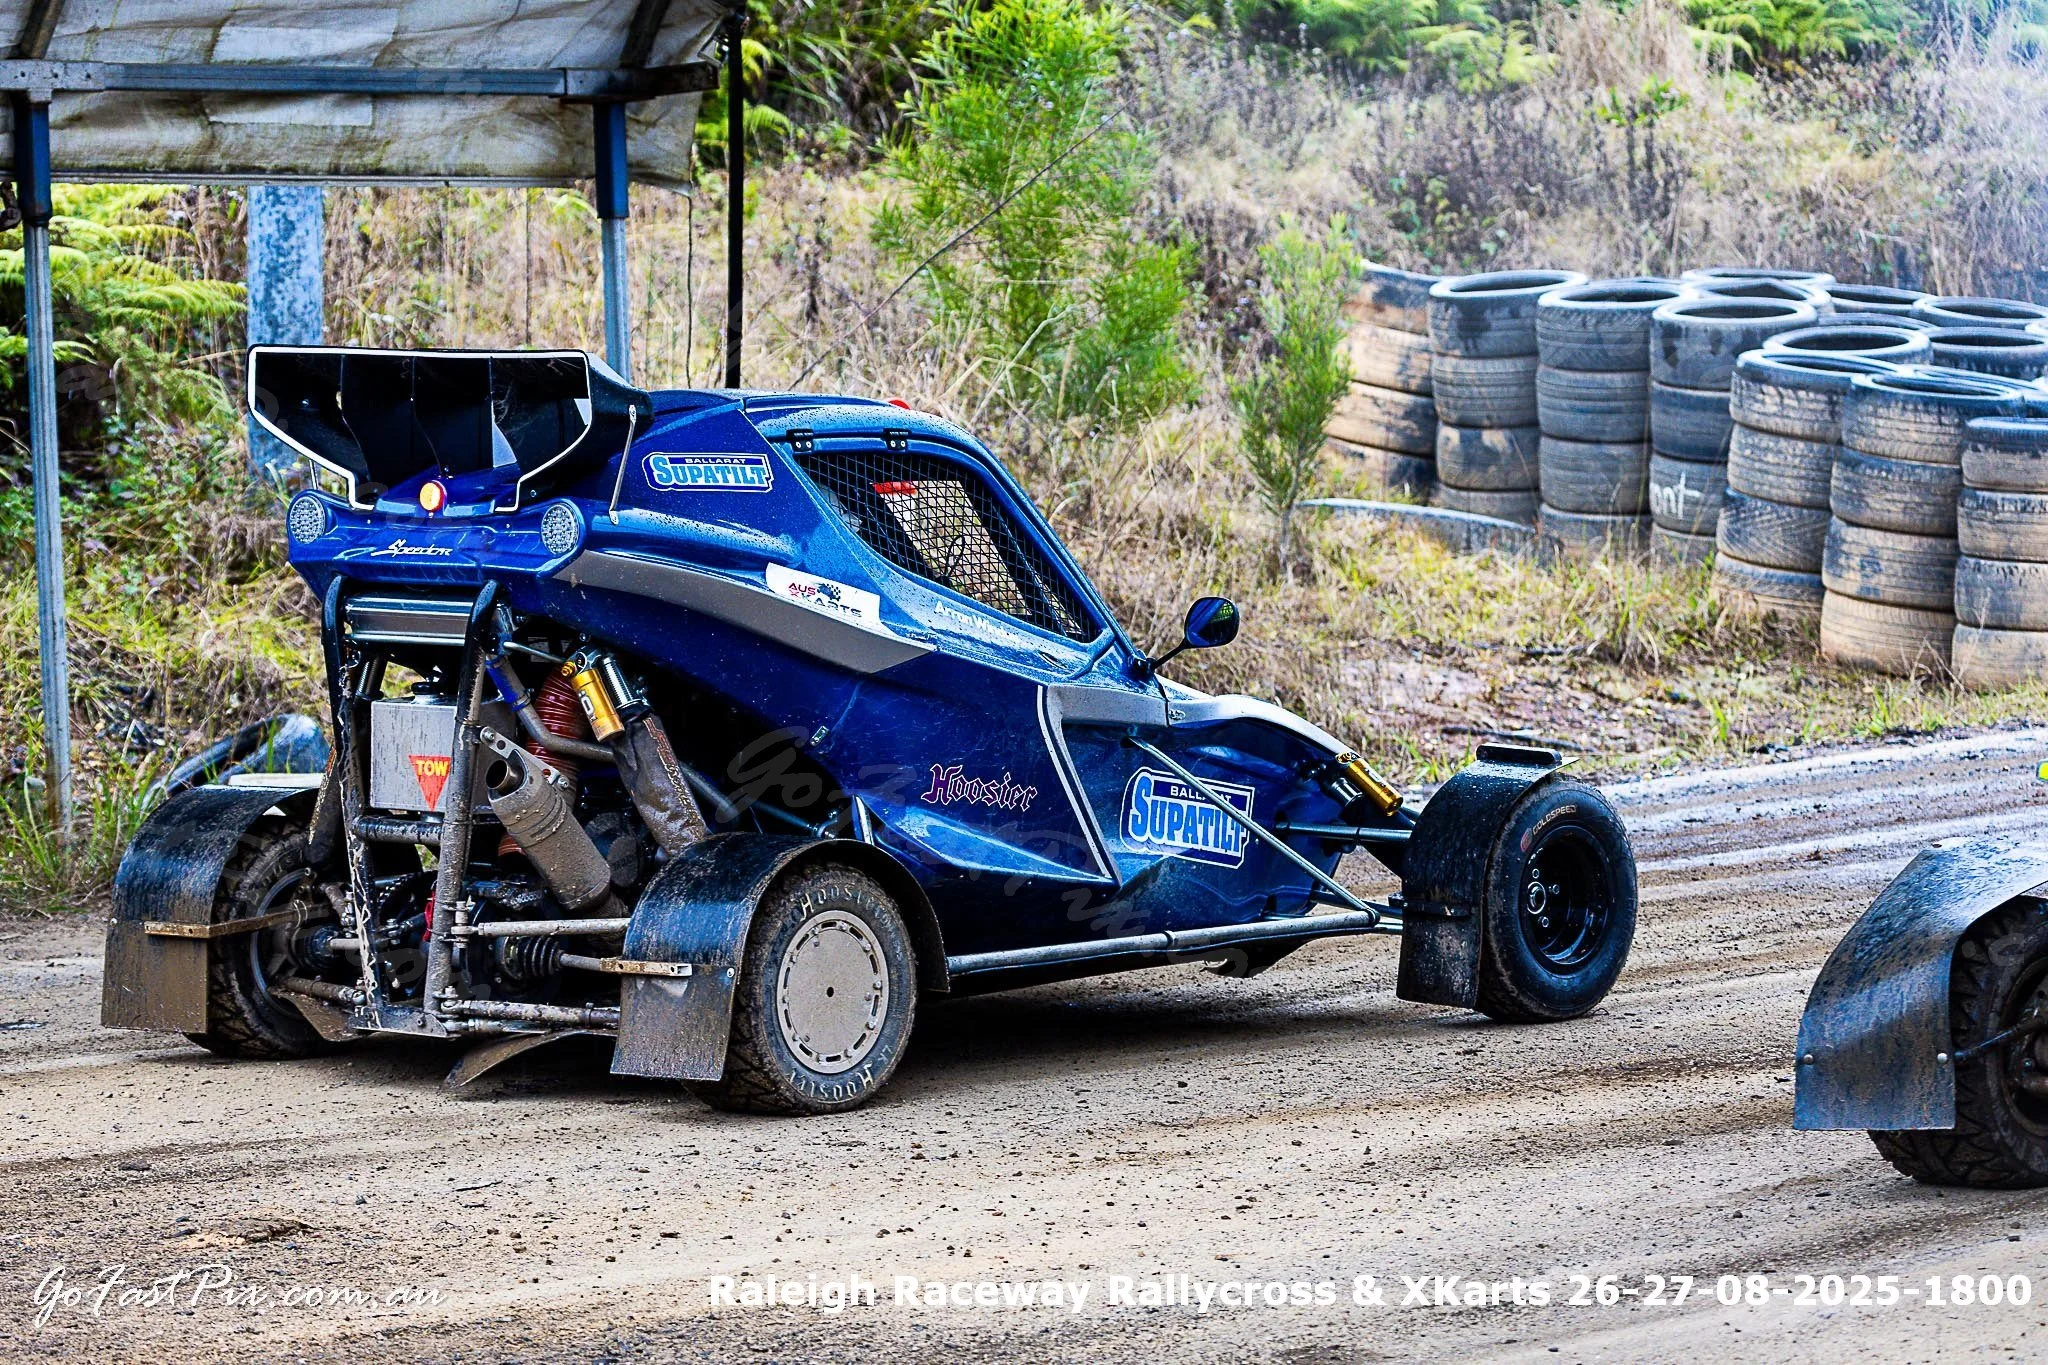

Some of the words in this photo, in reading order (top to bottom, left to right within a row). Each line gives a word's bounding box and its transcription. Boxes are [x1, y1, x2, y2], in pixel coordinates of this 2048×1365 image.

[651, 455, 768, 485] SUPATILT
[788, 582, 817, 597] AUS
[415, 759, 449, 777] TOW
[920, 763, 1038, 812] Hoosier
